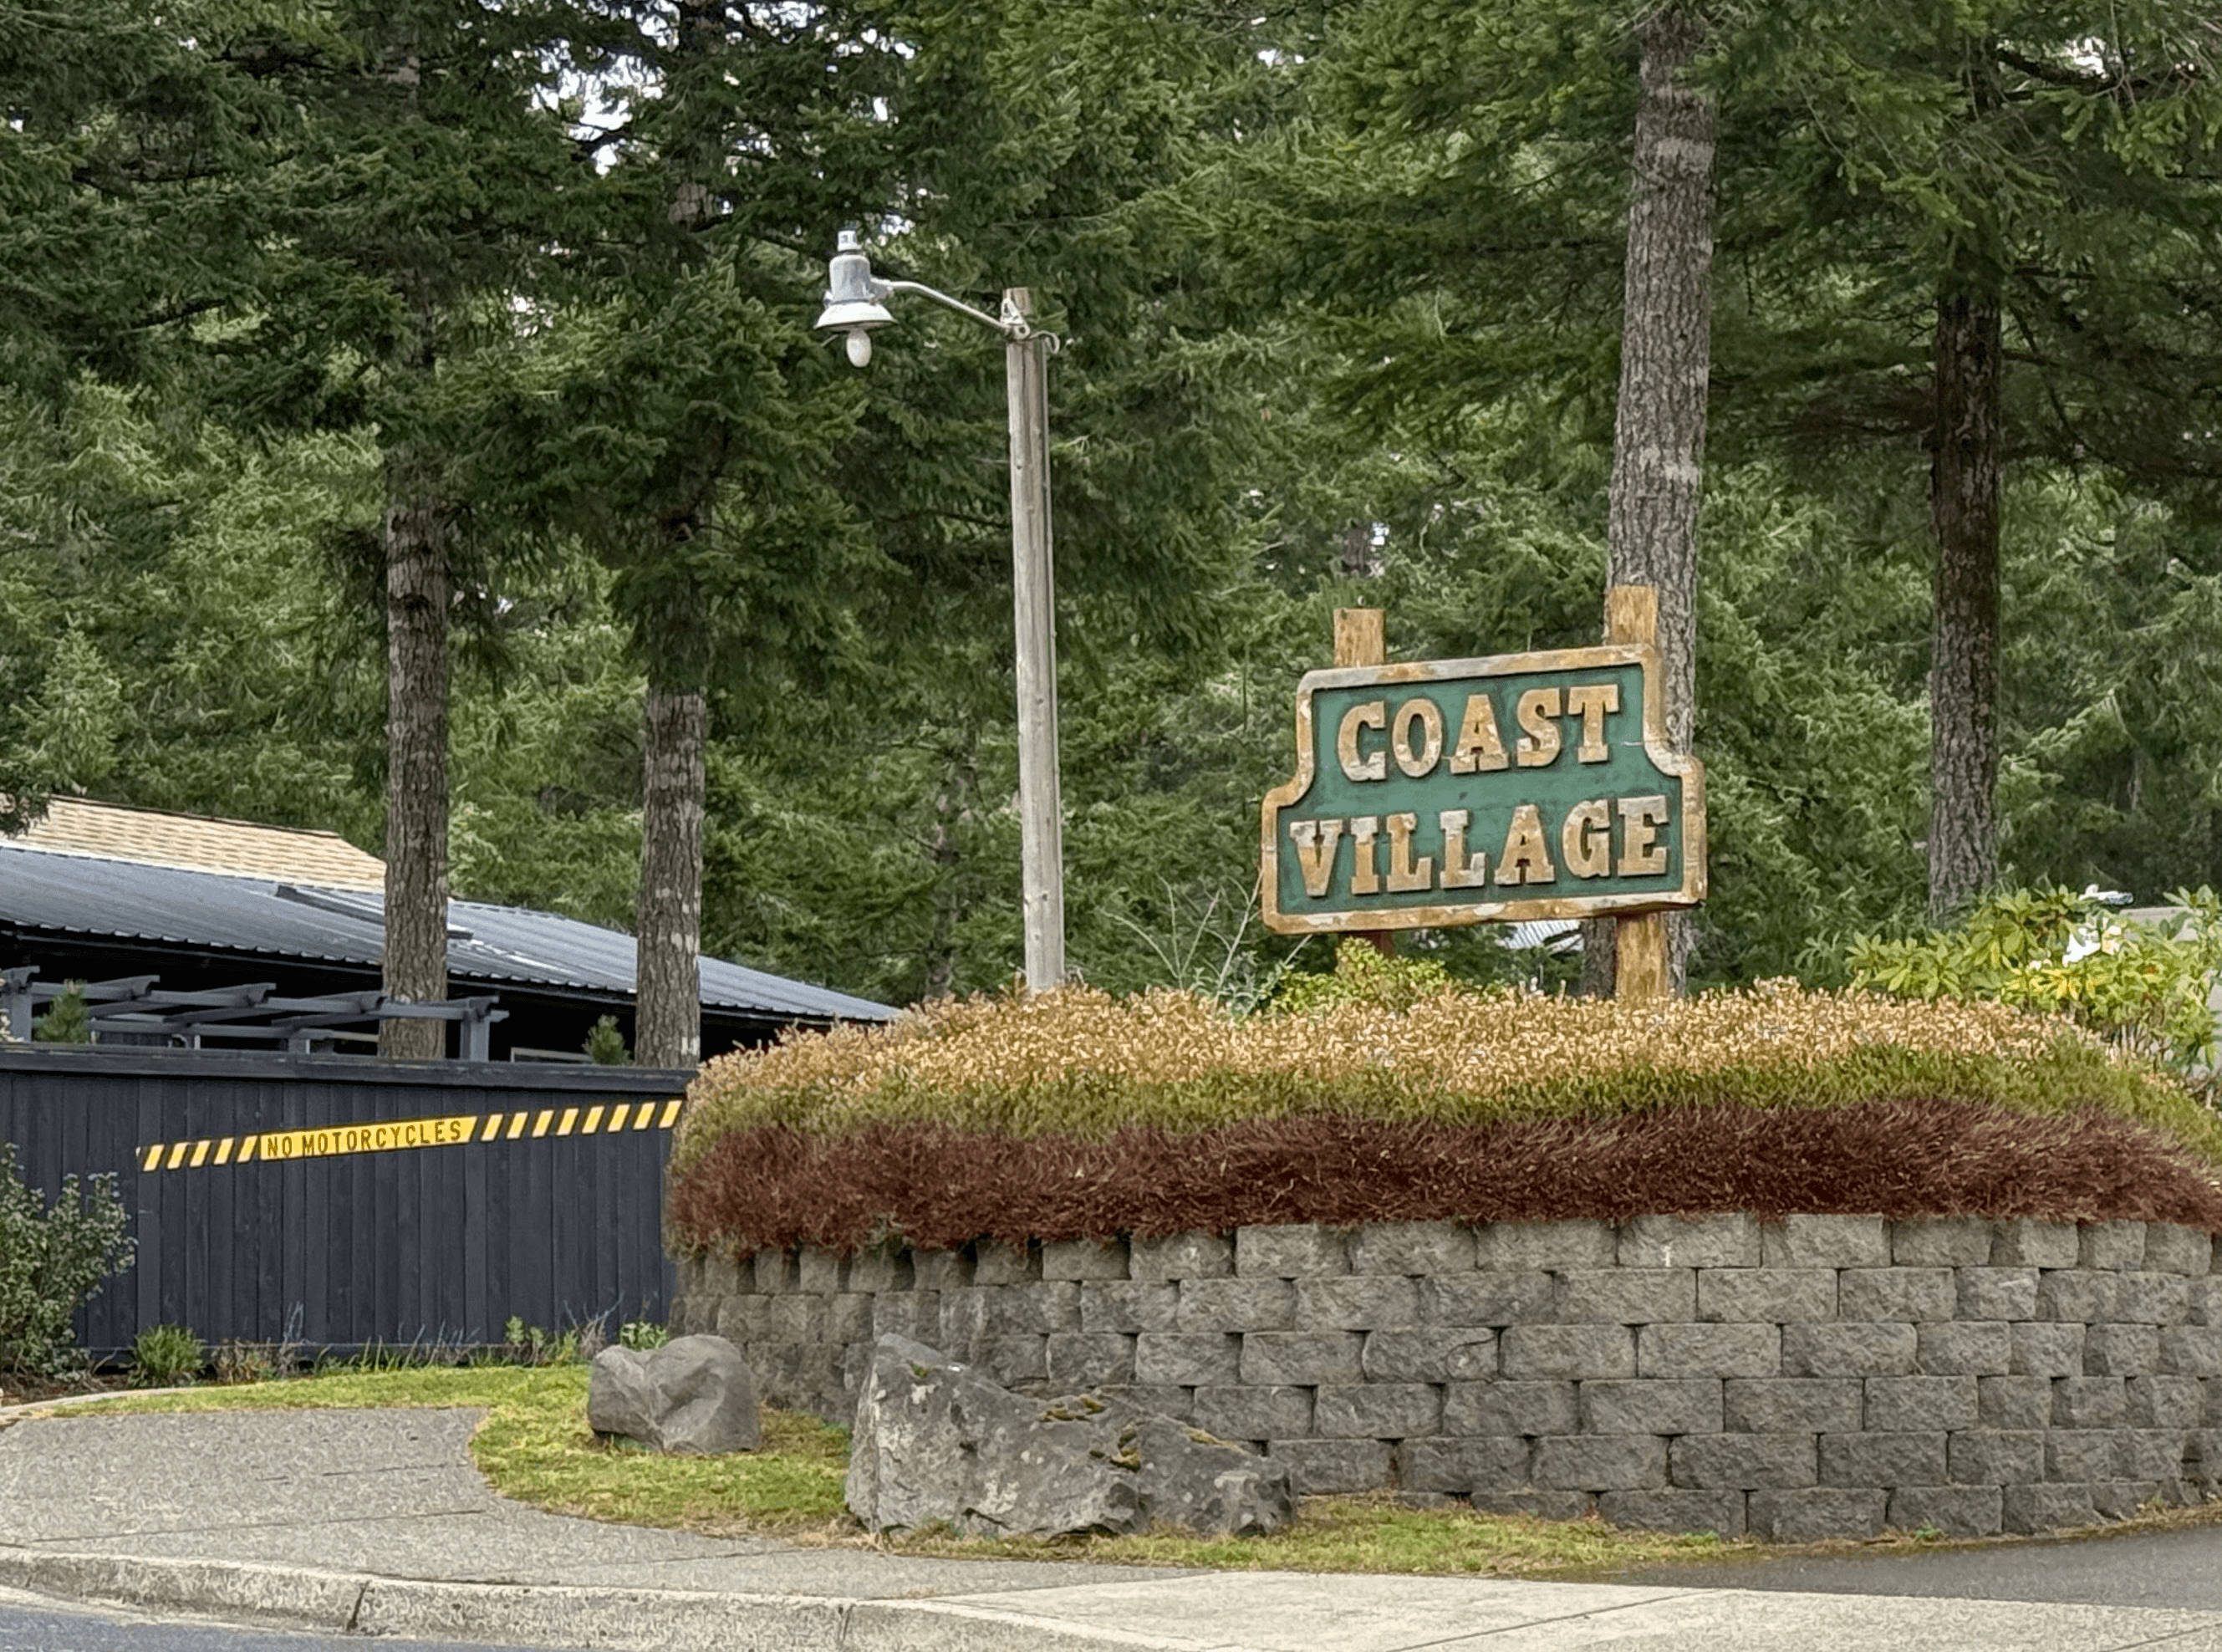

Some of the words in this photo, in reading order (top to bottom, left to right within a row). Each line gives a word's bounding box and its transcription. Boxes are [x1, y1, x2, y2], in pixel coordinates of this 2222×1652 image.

[1338, 683, 1619, 782] COAST
[1289, 794, 1669, 898] VILLAGE
[267, 1135, 293, 1157] NO
[302, 1120, 461, 1157] MOTORCYCLES
